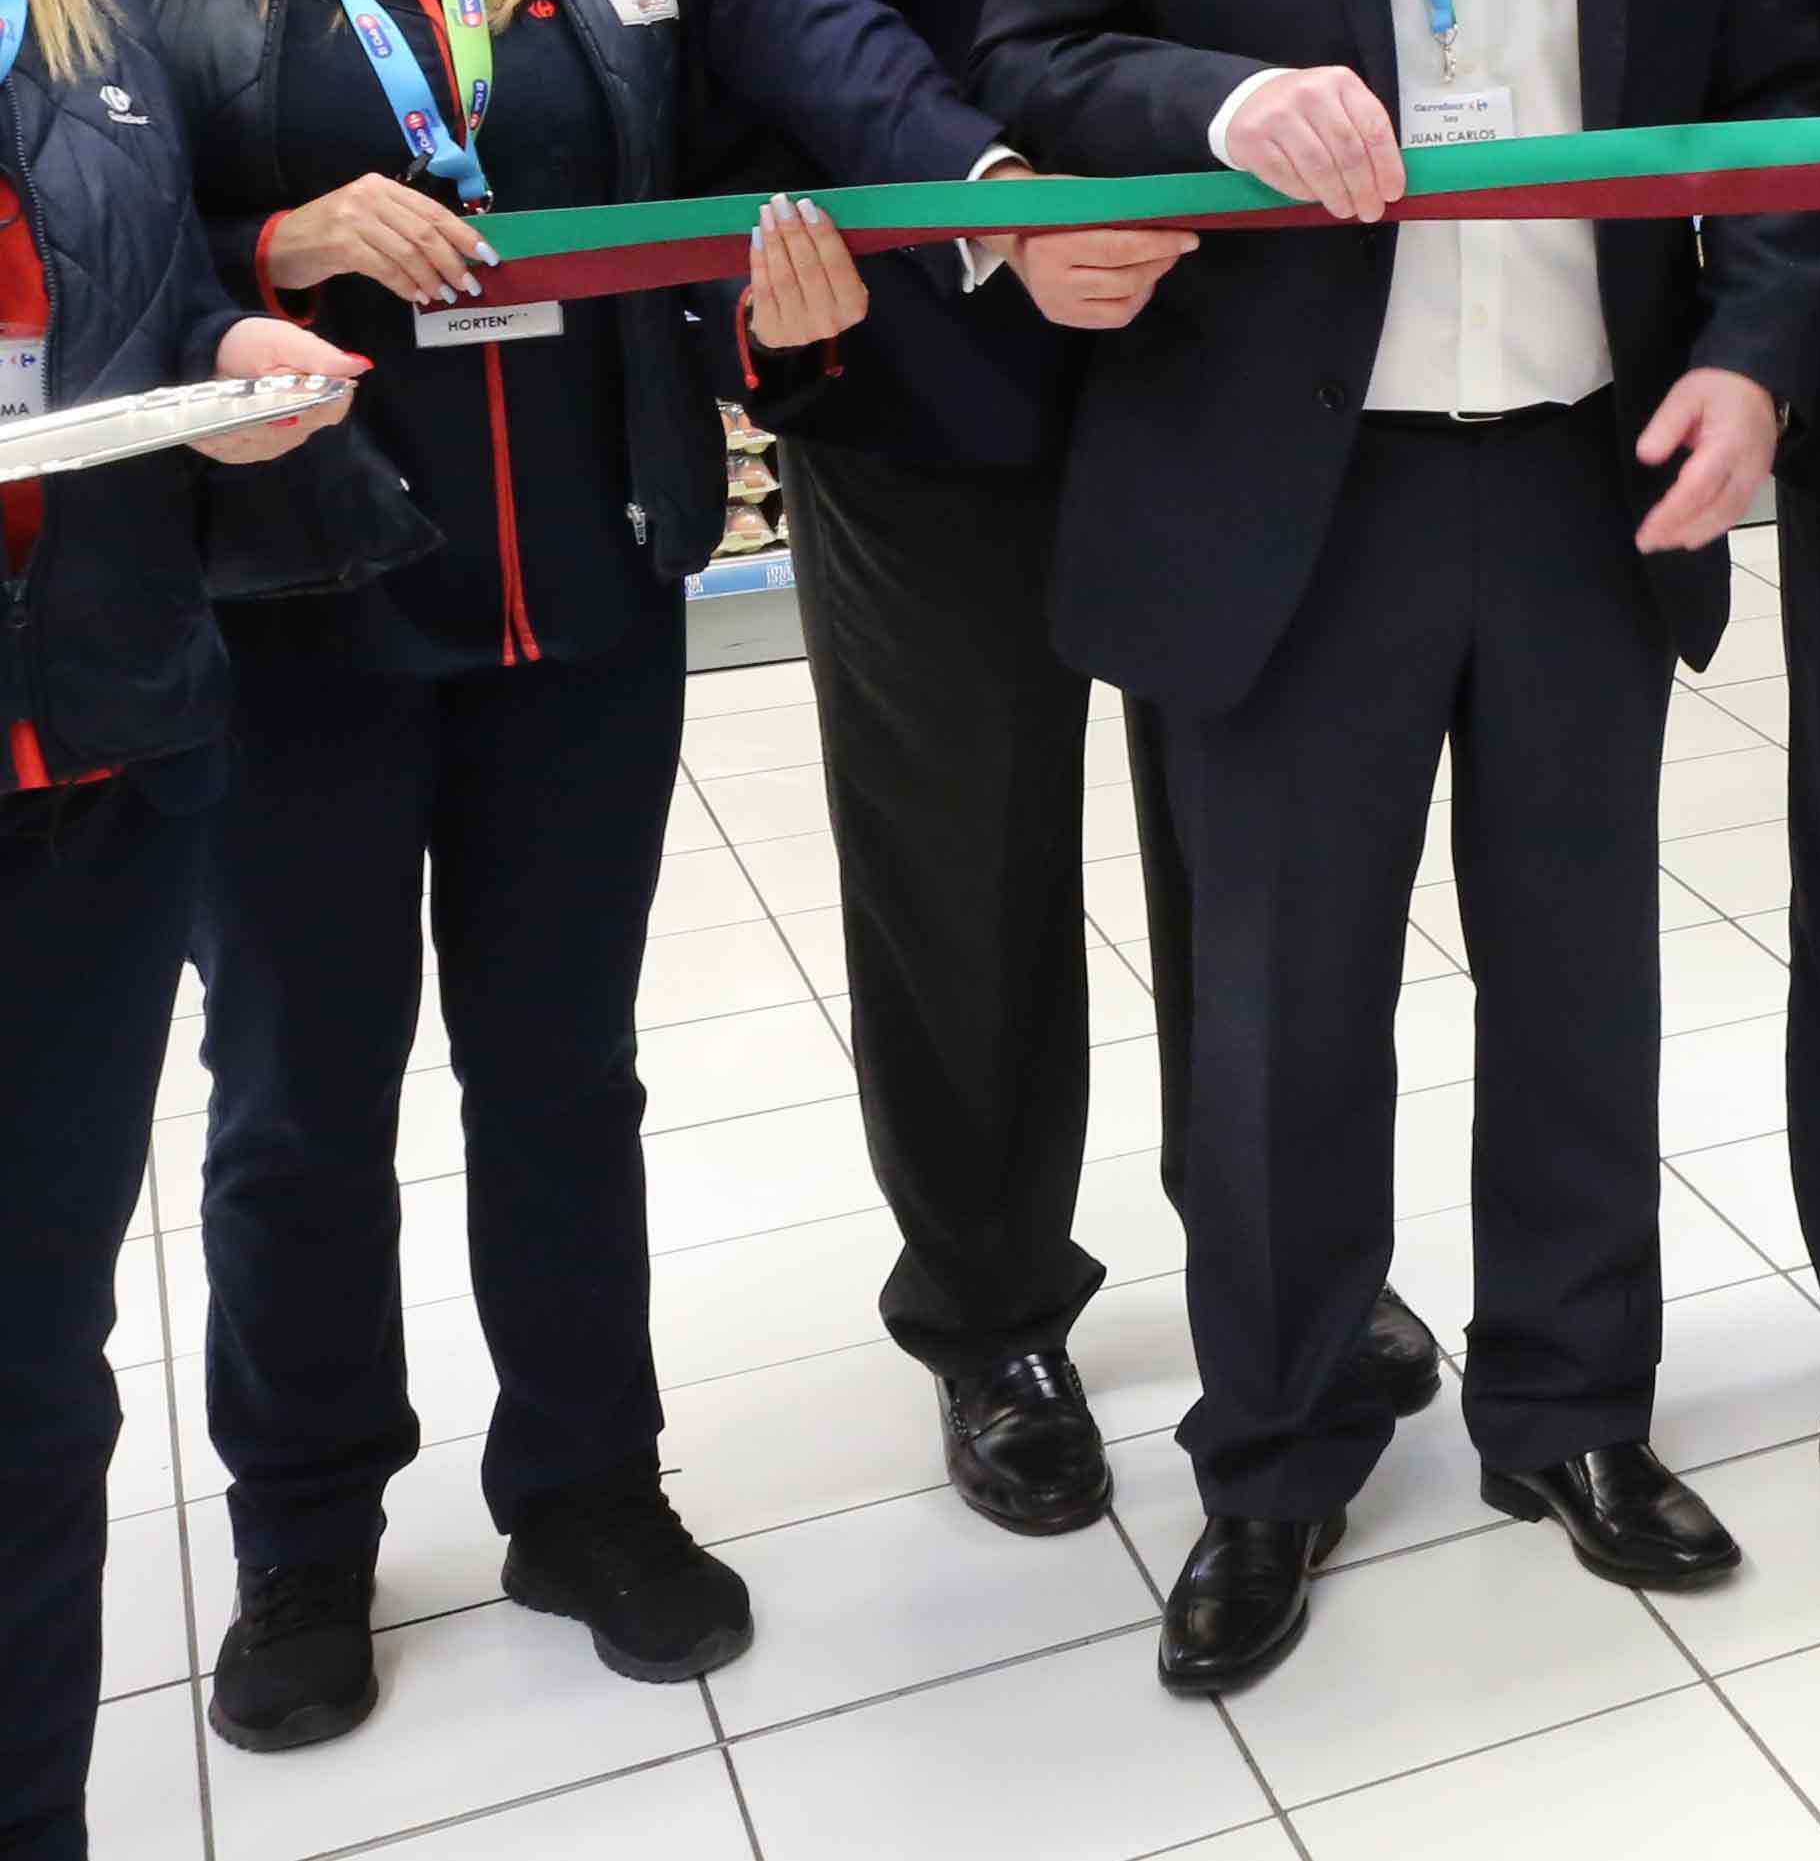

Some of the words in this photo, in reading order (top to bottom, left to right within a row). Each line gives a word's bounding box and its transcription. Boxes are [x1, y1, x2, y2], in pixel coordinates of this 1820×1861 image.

[1410, 133, 1442, 144] JUAN
[1446, 128, 1496, 141] CARLOS
[448, 312, 528, 332] HORTEN
